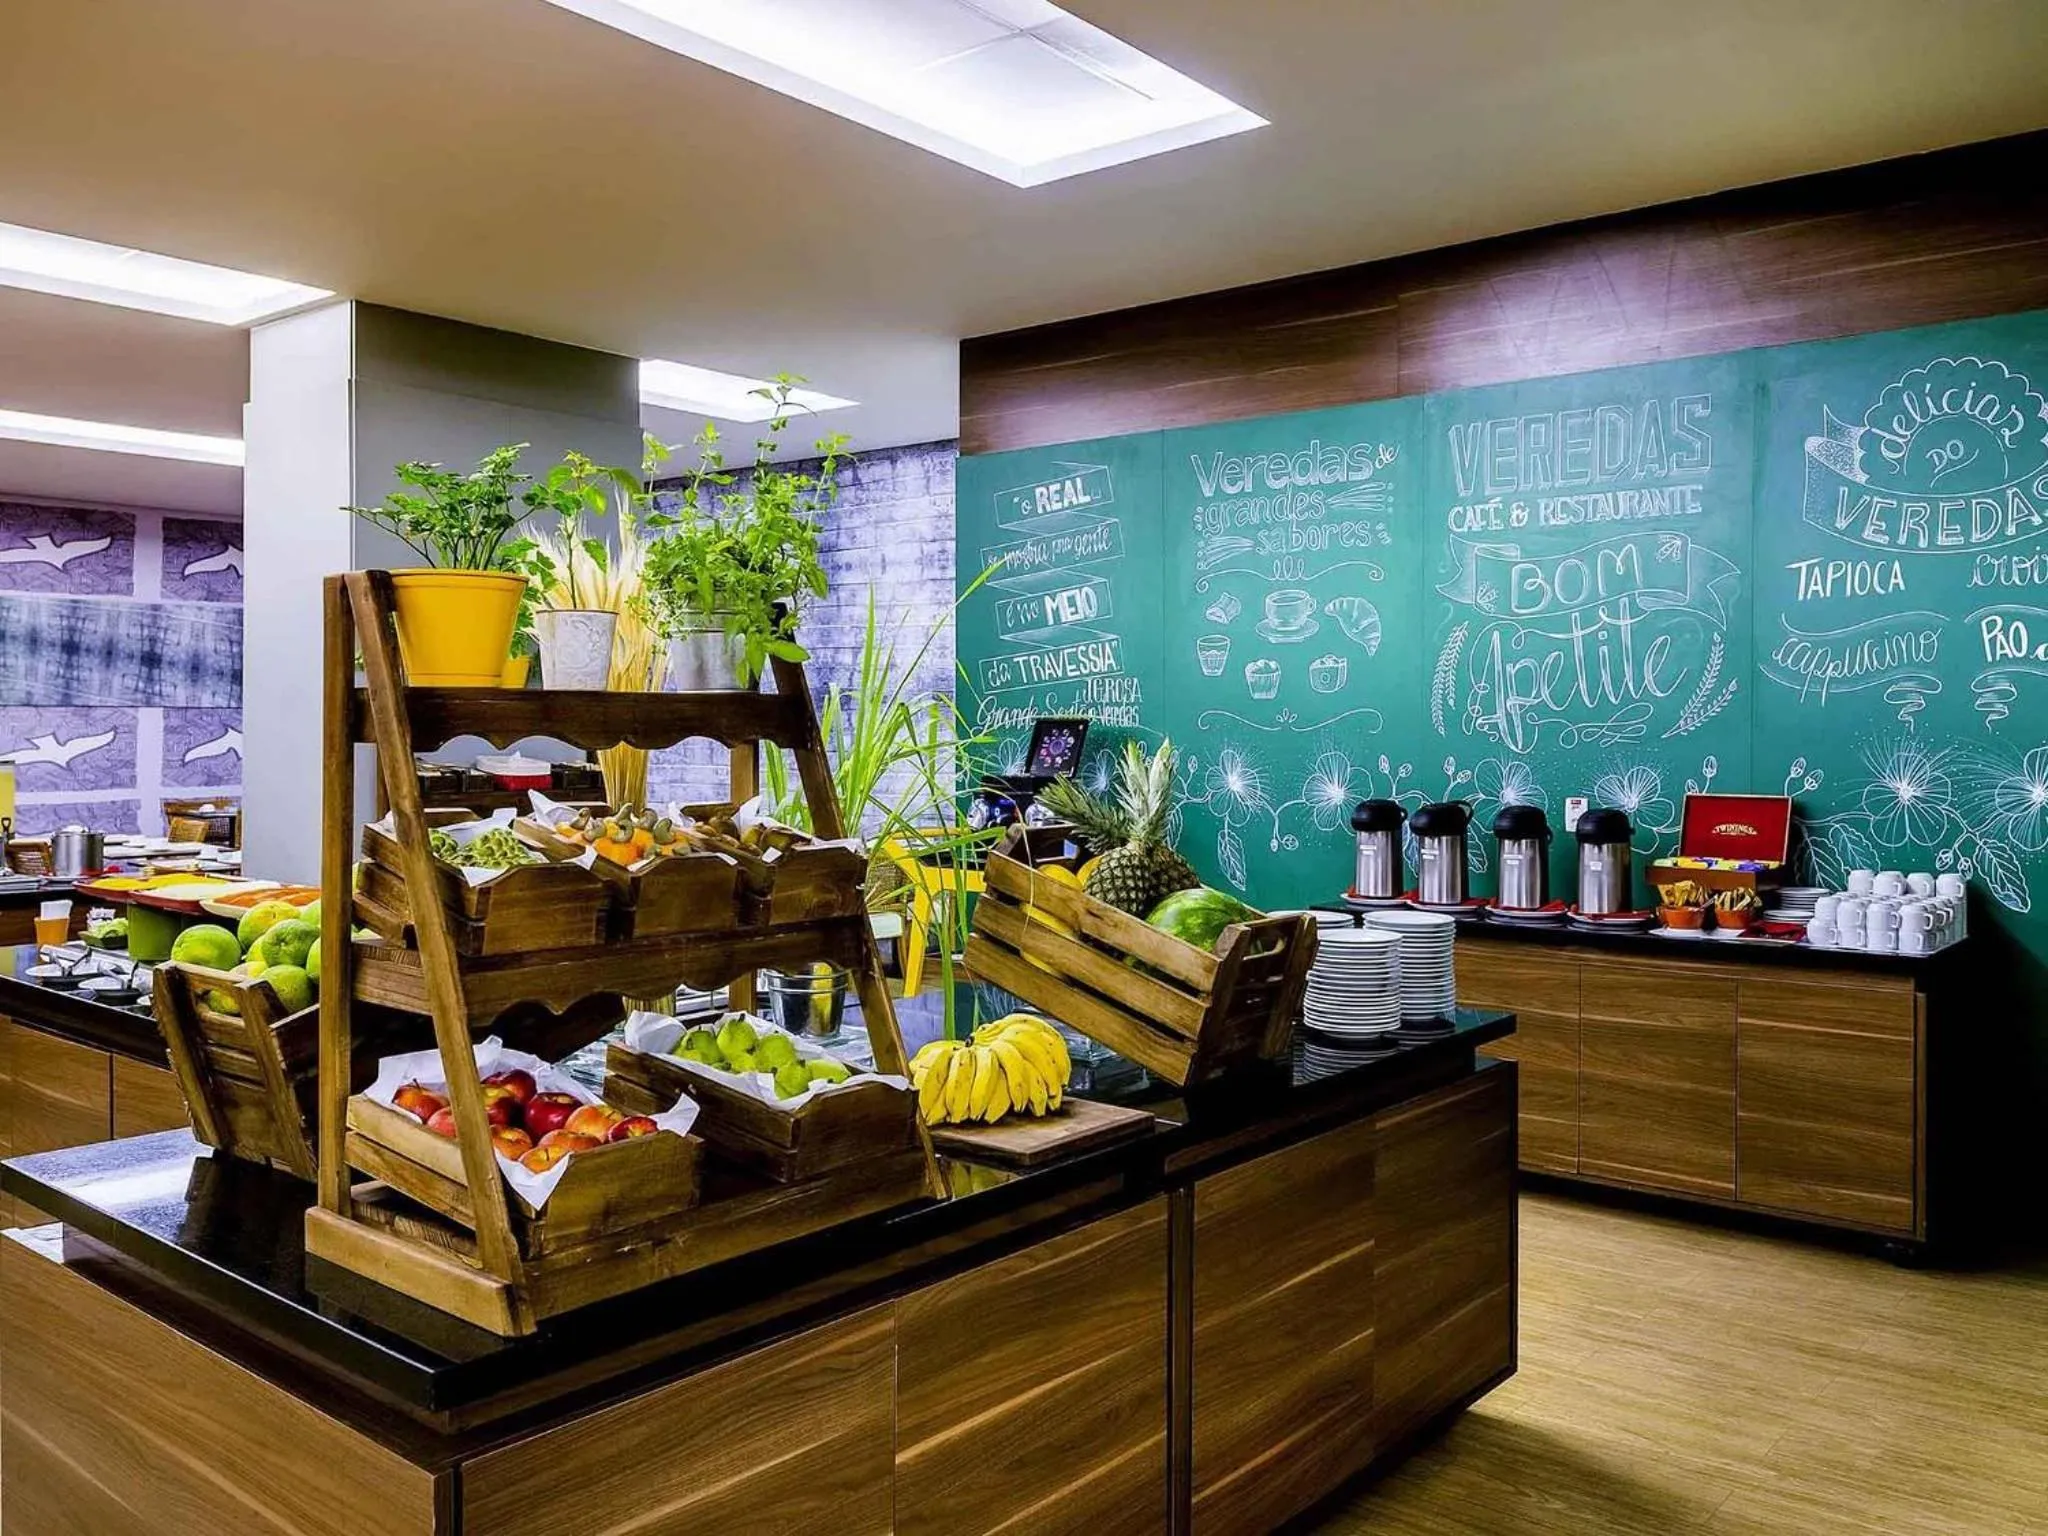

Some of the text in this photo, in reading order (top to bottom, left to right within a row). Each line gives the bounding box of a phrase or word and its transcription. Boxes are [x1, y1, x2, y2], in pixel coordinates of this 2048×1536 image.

[1447, 393, 1712, 497] VEREDAS
[1925, 439, 1964, 474] DO
[1190, 440, 1400, 498] Veredas de
[1035, 477, 1092, 514] REAL
[1203, 490, 1326, 539] grandes
[1447, 485, 1703, 533] CAFÉ & RESTAURANTE
[1256, 520, 1372, 556] sabores
[1511, 543, 1644, 615] BOM
[1786, 557, 1906, 601] TAPIOCA
[1043, 586, 1099, 626] MEIO
[987, 660, 1012, 688] da
[1462, 597, 1690, 757] Apetite
[1711, 823, 1758, 835] TWININGS
